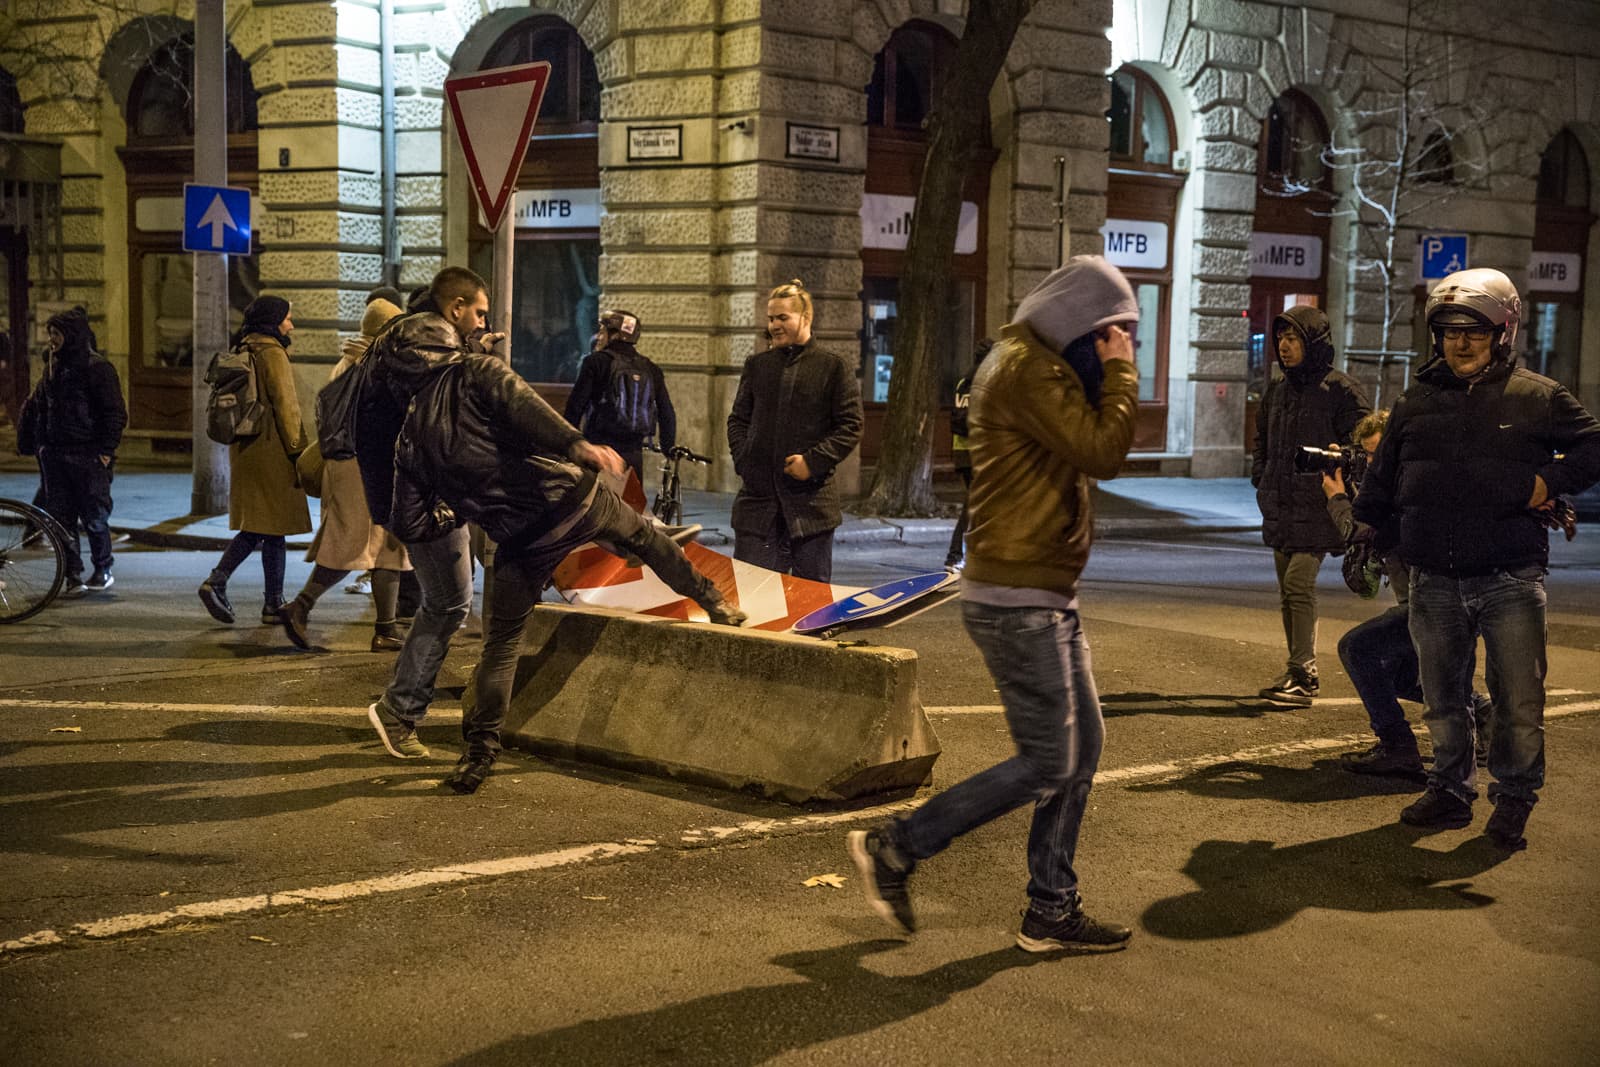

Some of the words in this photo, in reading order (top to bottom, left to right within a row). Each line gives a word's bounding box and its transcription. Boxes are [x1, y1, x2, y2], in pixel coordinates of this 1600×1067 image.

[532, 199, 572, 217] MFB
[1108, 231, 1148, 254] MFB
[1429, 240, 1443, 261] P
[1270, 244, 1305, 266] MFB
[1538, 262, 1567, 281] MFB
[955, 392, 971, 408] VA
